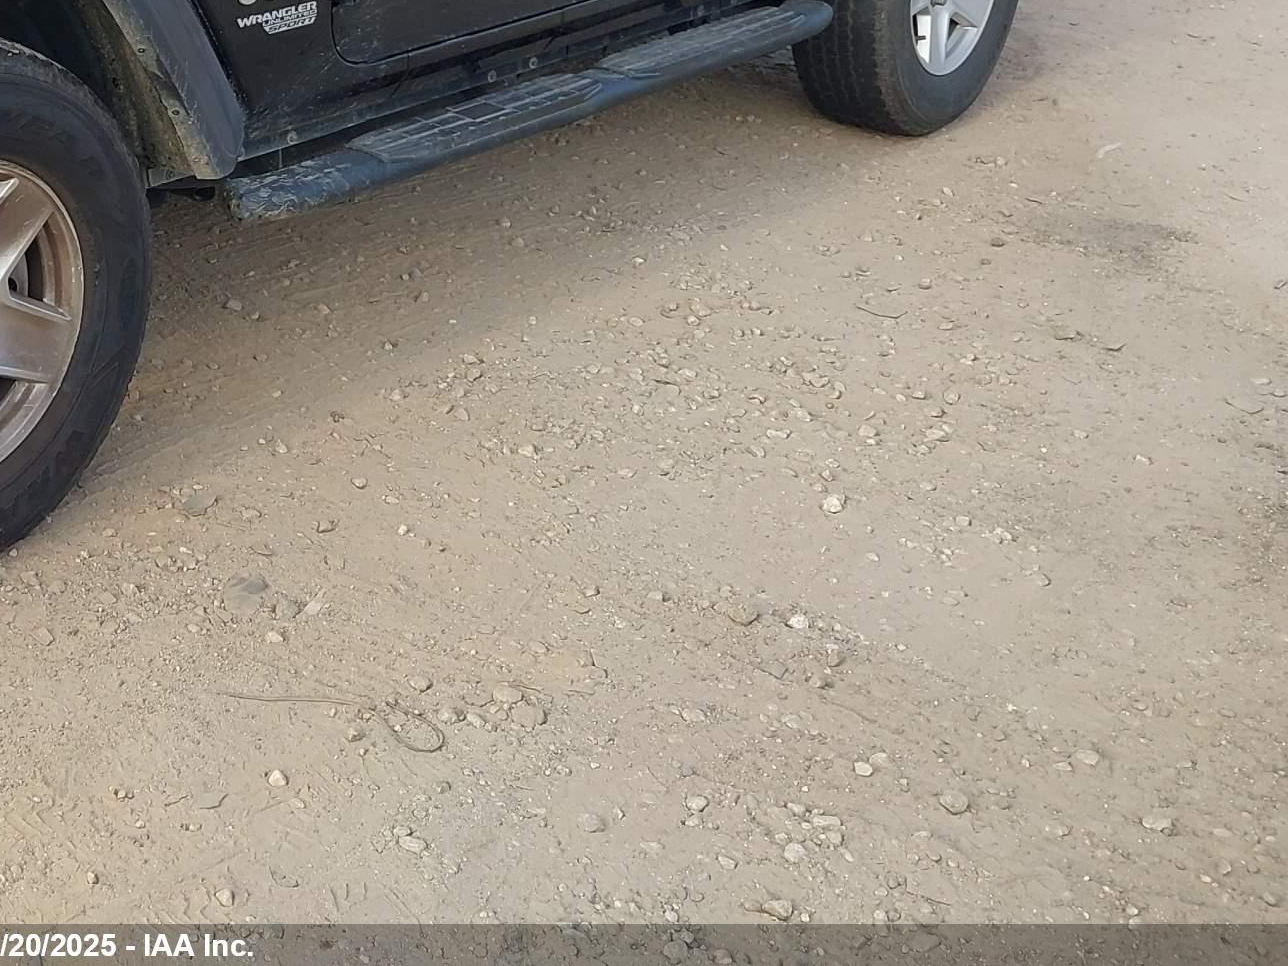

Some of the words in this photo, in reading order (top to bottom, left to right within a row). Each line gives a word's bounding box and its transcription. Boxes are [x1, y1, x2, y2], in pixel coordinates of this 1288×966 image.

[236, 1, 317, 28] WRANGLER
[263, 10, 318, 27] UNLIMITED
[268, 17, 315, 33] SPORT
